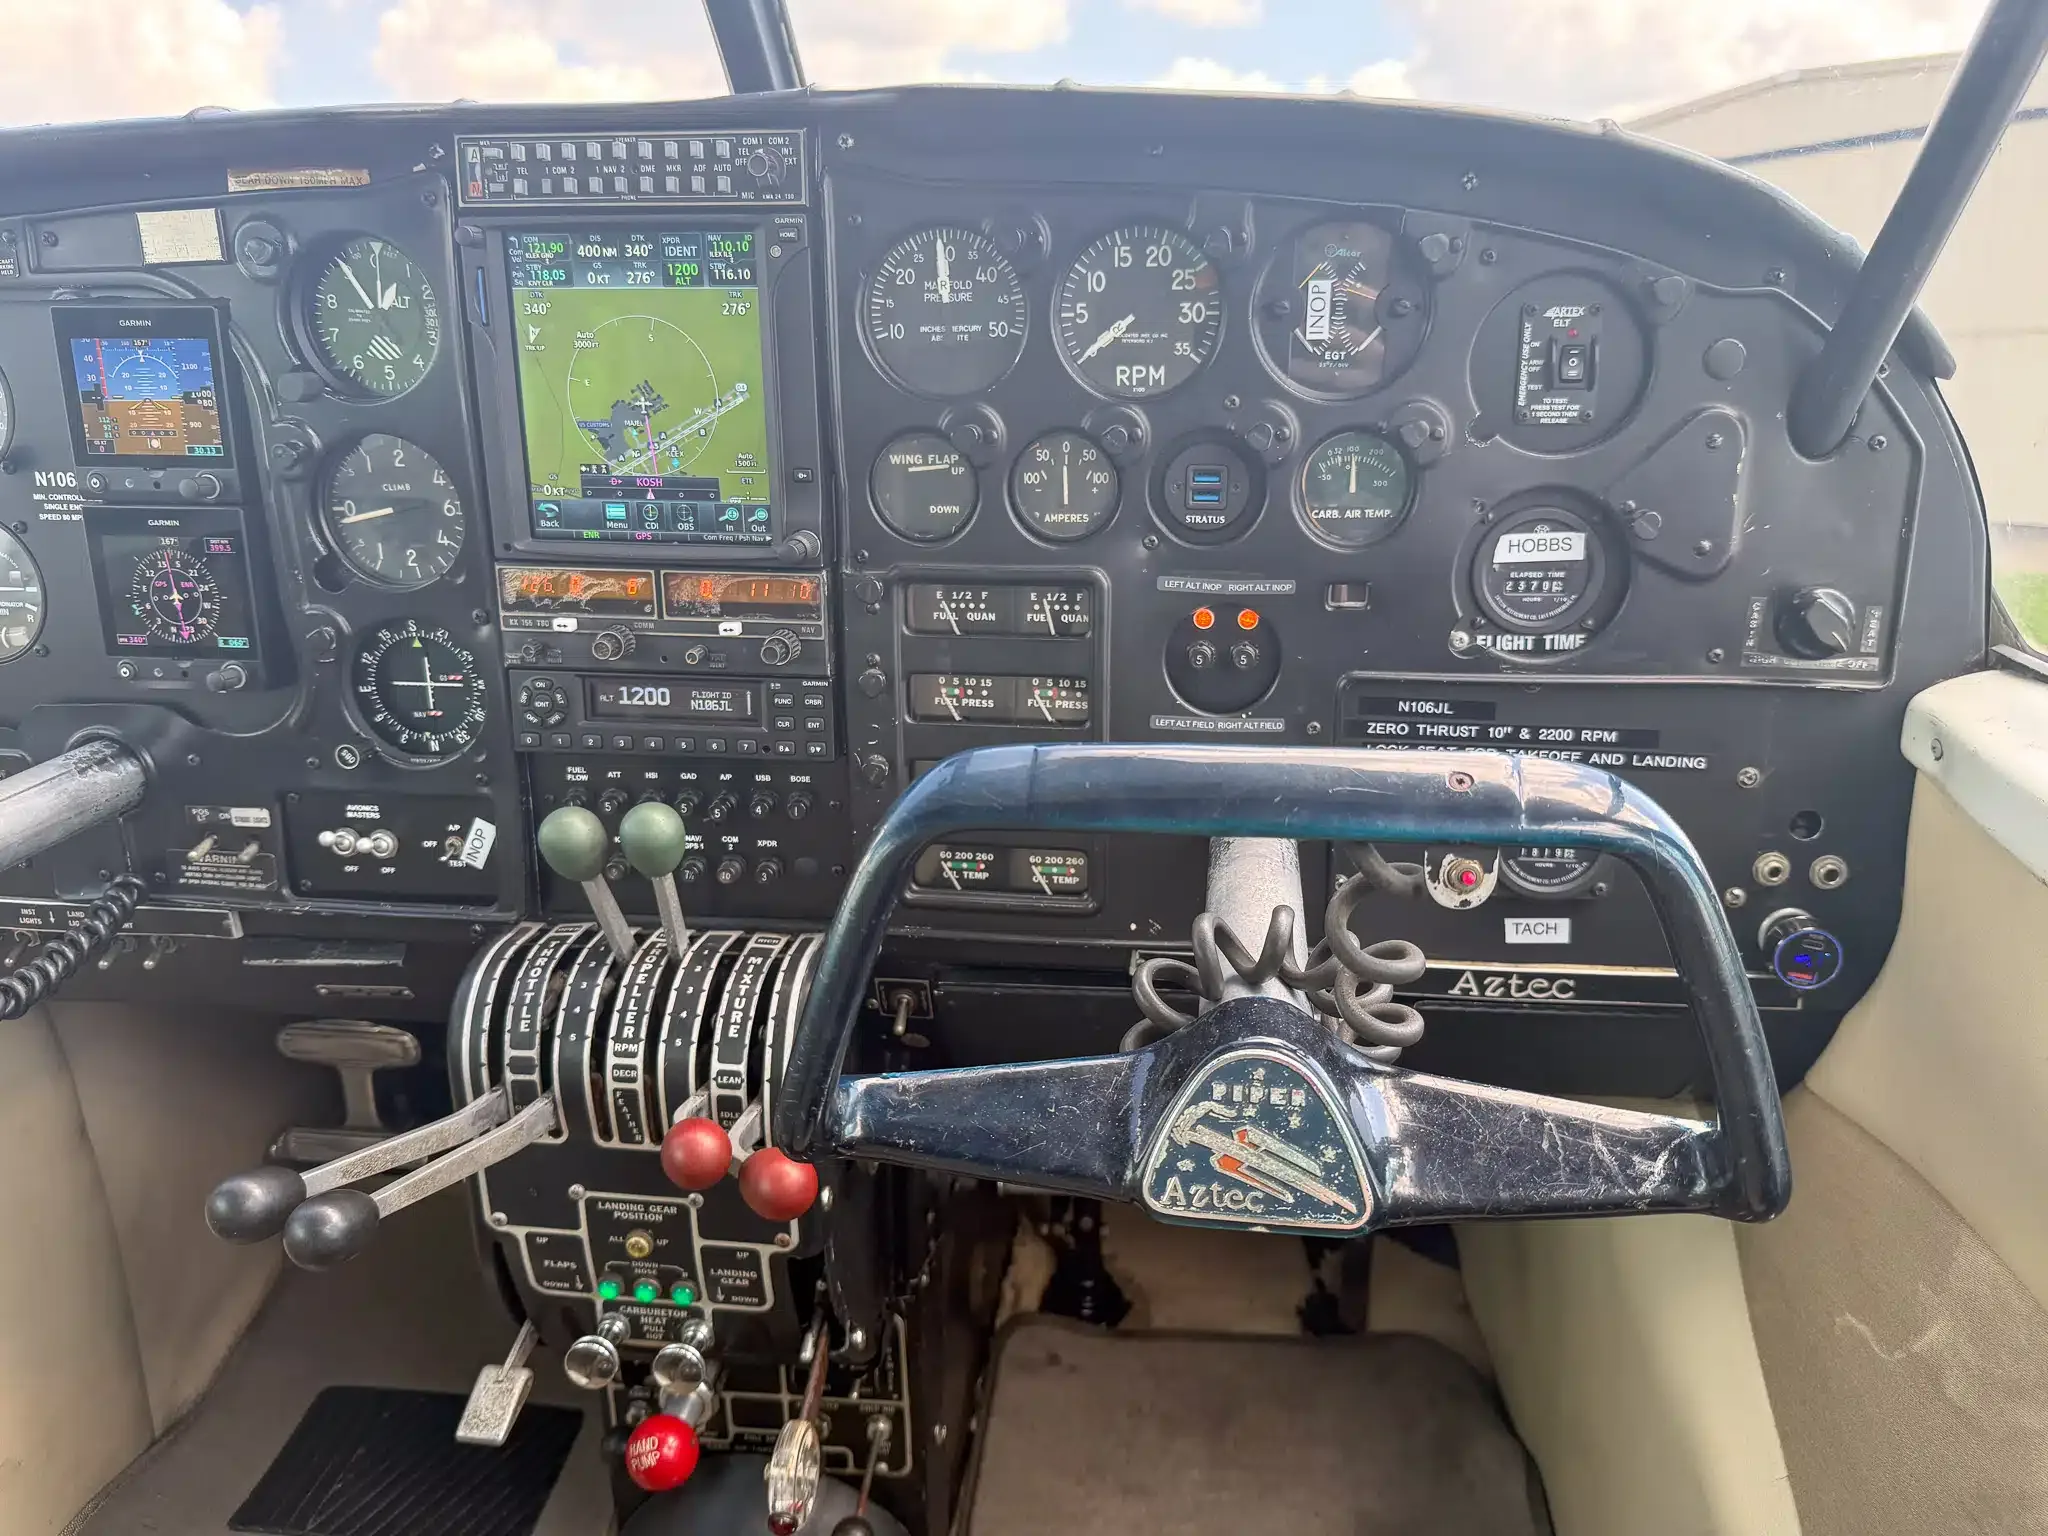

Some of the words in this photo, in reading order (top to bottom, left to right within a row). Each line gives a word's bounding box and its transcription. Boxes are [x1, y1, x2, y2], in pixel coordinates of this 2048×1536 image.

[735, 158, 747, 166] OFF
[517, 167, 528, 175] TEL
[640, 165, 656, 173] DME
[694, 164, 706, 172] ADF
[714, 164, 732, 172] AUTO
[631, 234, 645, 242] DTK
[528, 242, 564, 253] 121.90
[624, 244, 654, 257] 340°
[665, 246, 697, 257] IDENT
[713, 241, 749, 252] 110.10
[577, 246, 601, 258] 400
[602, 248, 617, 257] NM
[1114, 246, 1132, 268] 15
[1146, 246, 1172, 267] 20
[667, 264, 698, 276] 1200
[714, 269, 750, 280] 116.10
[976, 268, 997, 282] 40
[531, 270, 566, 281] 118.05
[627, 271, 655, 284] 276°
[896, 268, 915, 284] 20
[675, 277, 691, 285] ALT
[925, 280, 972, 290] MAFOLD
[924, 292, 972, 302] PRESURE
[1179, 303, 1205, 322] 30
[1309, 284, 1326, 334] INOP
[1553, 319, 1571, 327] ELT
[576, 331, 594, 339] Auto
[1523, 322, 1532, 342] ONLY
[573, 340, 591, 348] 3000
[1324, 352, 1346, 360] EGT
[1116, 366, 1165, 386] RPM
[890, 455, 923, 465] WING
[928, 455, 959, 464] FLAP
[951, 467, 964, 475] UP
[34, 471, 76, 487] N106
[637, 478, 663, 487] KOSH
[930, 506, 960, 514] DOWN
[1312, 510, 1342, 519] CARB.
[1344, 510, 1361, 518] AIR
[1364, 509, 1393, 518] TEMP.
[1044, 514, 1089, 523] AMPERES
[1185, 515, 1225, 524] STRATUS
[541, 520, 559, 528] Back
[607, 521, 628, 530] Menu
[645, 522, 659, 530] CDI
[752, 524, 766, 532] Out
[584, 531, 600, 539] ENR
[636, 532, 652, 540] GPS
[719, 535, 734, 543] Freq
[1508, 537, 1572, 553] HOBBS
[933, 612, 959, 620] FUEL
[967, 613, 995, 621] QUAN
[1543, 634, 1588, 650] TIME
[619, 686, 670, 706] 1200
[692, 691, 719, 699] FLIGHT
[691, 700, 732, 712] N106JL
[935, 697, 959, 706] FUEL
[962, 698, 994, 707] PRESS
[1398, 700, 1454, 715] N106JL
[1367, 722, 1409, 736] ZERO
[1417, 723, 1479, 738] THRUST
[1519, 728, 1531, 740] &
[1538, 728, 1573, 742] 2200
[1581, 729, 1618, 743] RPM
[1589, 752, 1624, 765] AND
[1632, 754, 1706, 769] LANDING
[346, 804, 379, 812] AVIONICS
[467, 827, 487, 863] INOP
[962, 871, 989, 880] TEMP
[19, 917, 42, 925] LIGHTS
[1512, 922, 1558, 936] TACH
[520, 940, 560, 1032] THROTTLE
[1447, 971, 1577, 1000] Aztec
[728, 957, 763, 1038] MIXTURE
[614, 1042, 638, 1052] RPM
[613, 1069, 637, 1078] DECR
[718, 1076, 741, 1084] LEAN
[1212, 1082, 1306, 1106] PIPER
[1160, 1175, 1264, 1212] Aztec
[598, 1202, 644, 1212] LANDING
[650, 1205, 677, 1214] GEAR
[614, 1211, 663, 1221] POSITION
[544, 1260, 577, 1269] FLAPS
[710, 1269, 757, 1278] LANDING
[620, 1305, 688, 1317] CARBURETOR
[631, 1450, 660, 1472] PUMP
